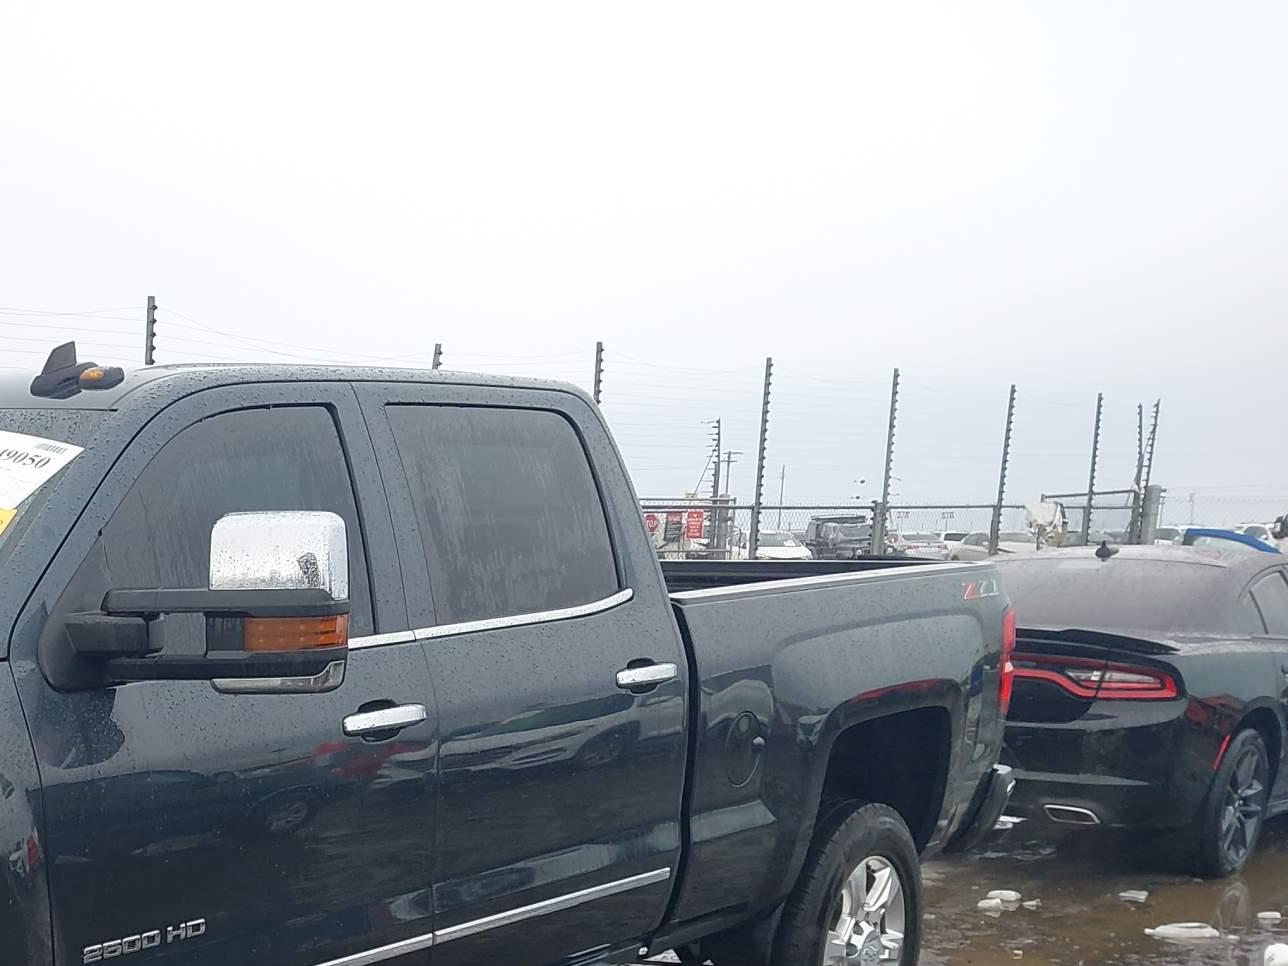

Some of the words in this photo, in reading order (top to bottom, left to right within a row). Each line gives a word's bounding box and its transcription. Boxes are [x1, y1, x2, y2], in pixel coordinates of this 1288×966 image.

[961, 578, 1000, 600] Z71
[83, 929, 161, 964] 2500
[166, 918, 206, 943] HD
